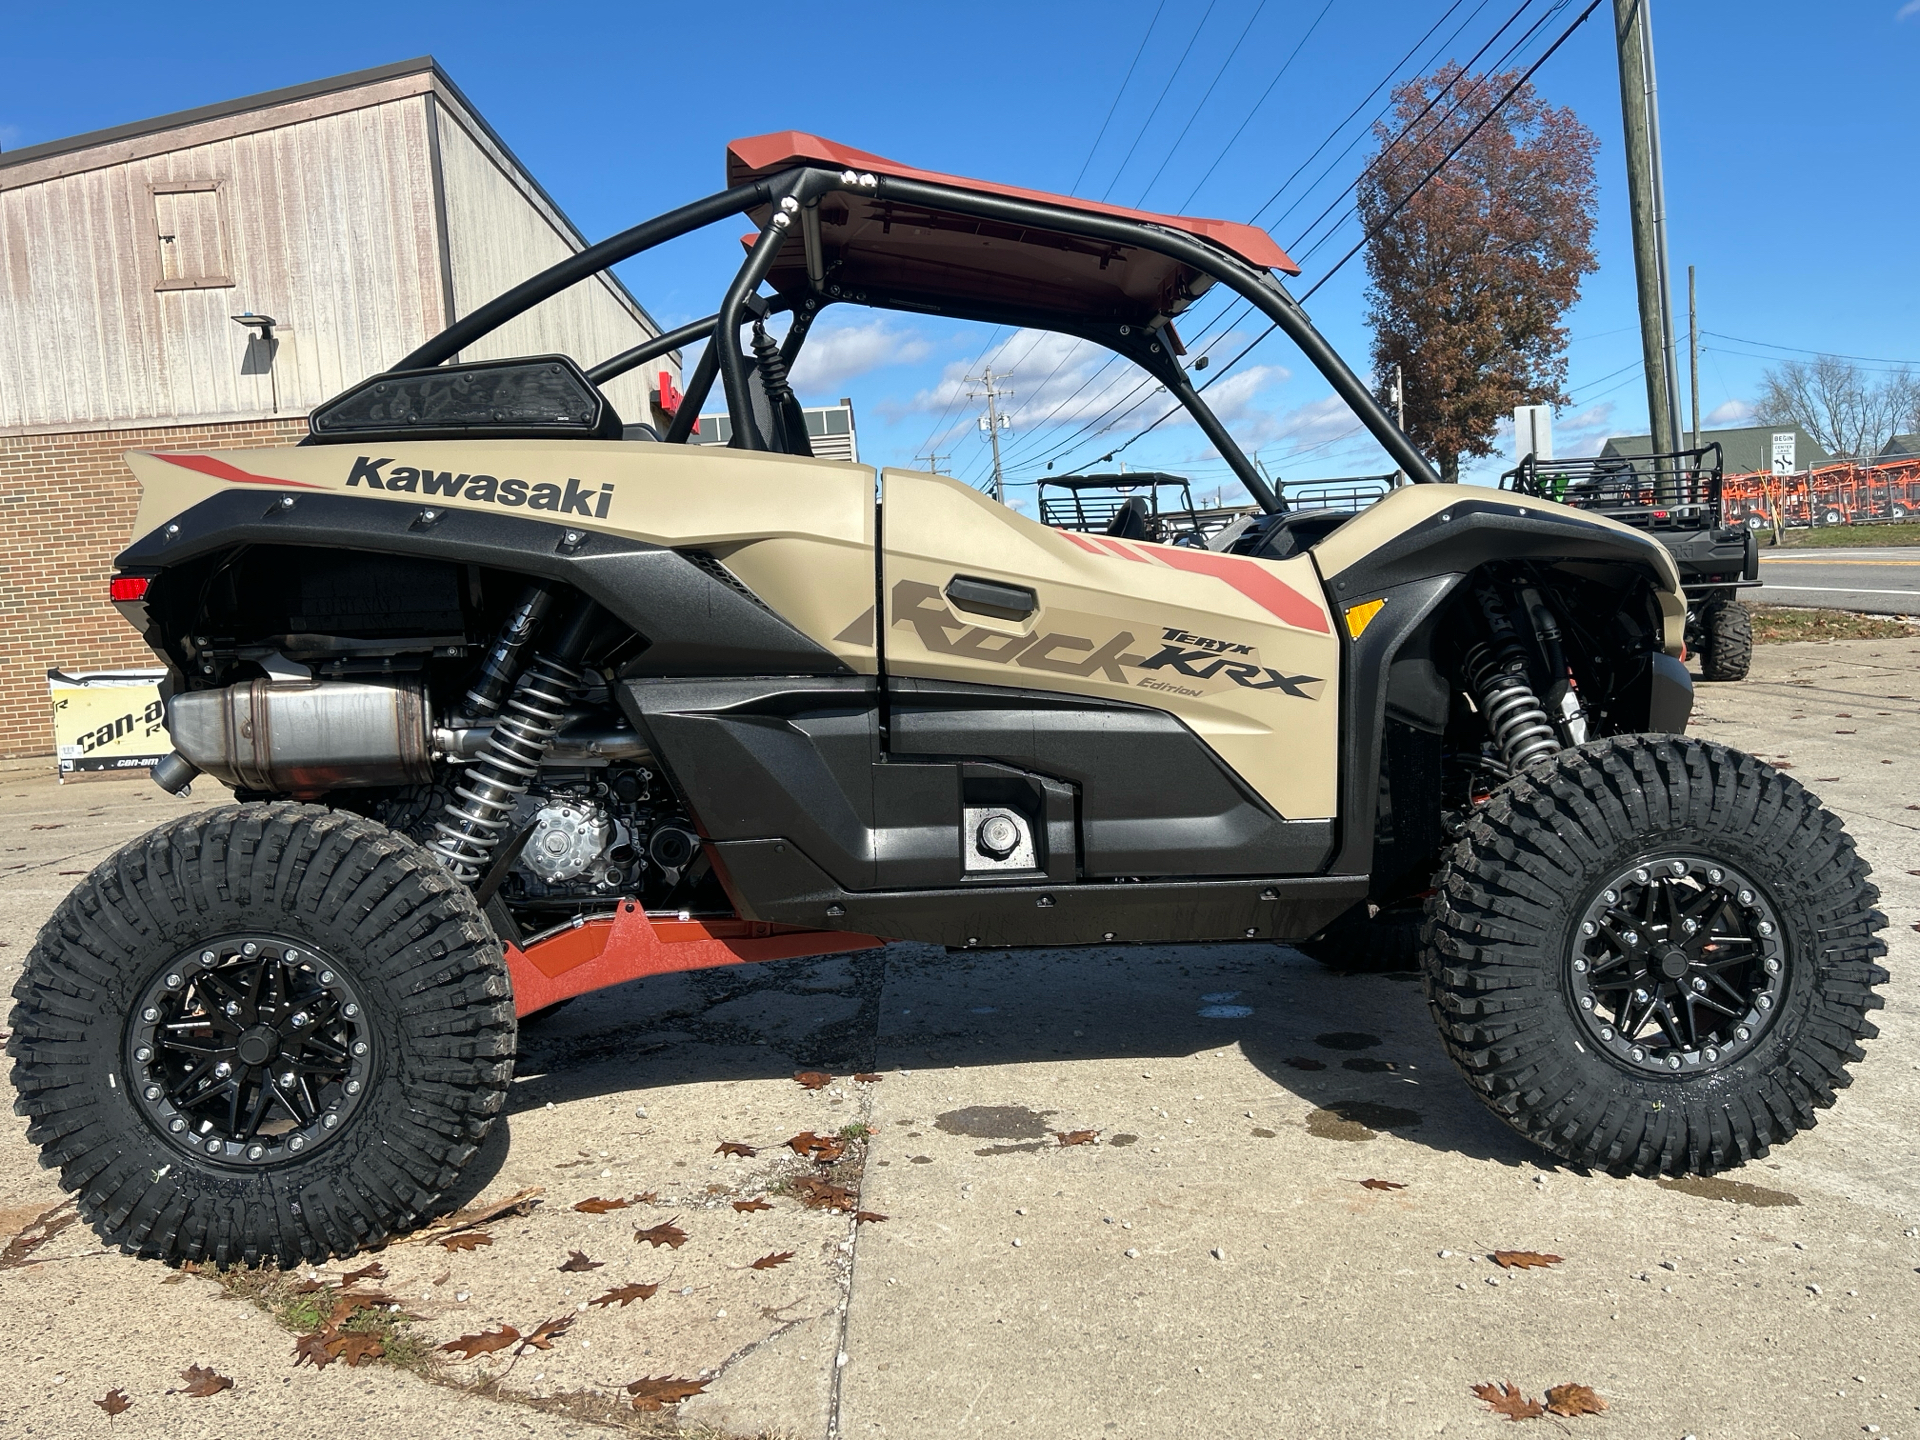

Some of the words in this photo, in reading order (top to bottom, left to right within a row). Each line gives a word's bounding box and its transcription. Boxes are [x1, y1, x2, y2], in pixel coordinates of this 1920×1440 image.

[346, 456, 615, 519] Kawasaki
[1138, 643, 1325, 700] KRX
[76, 700, 162, 754] can-a
